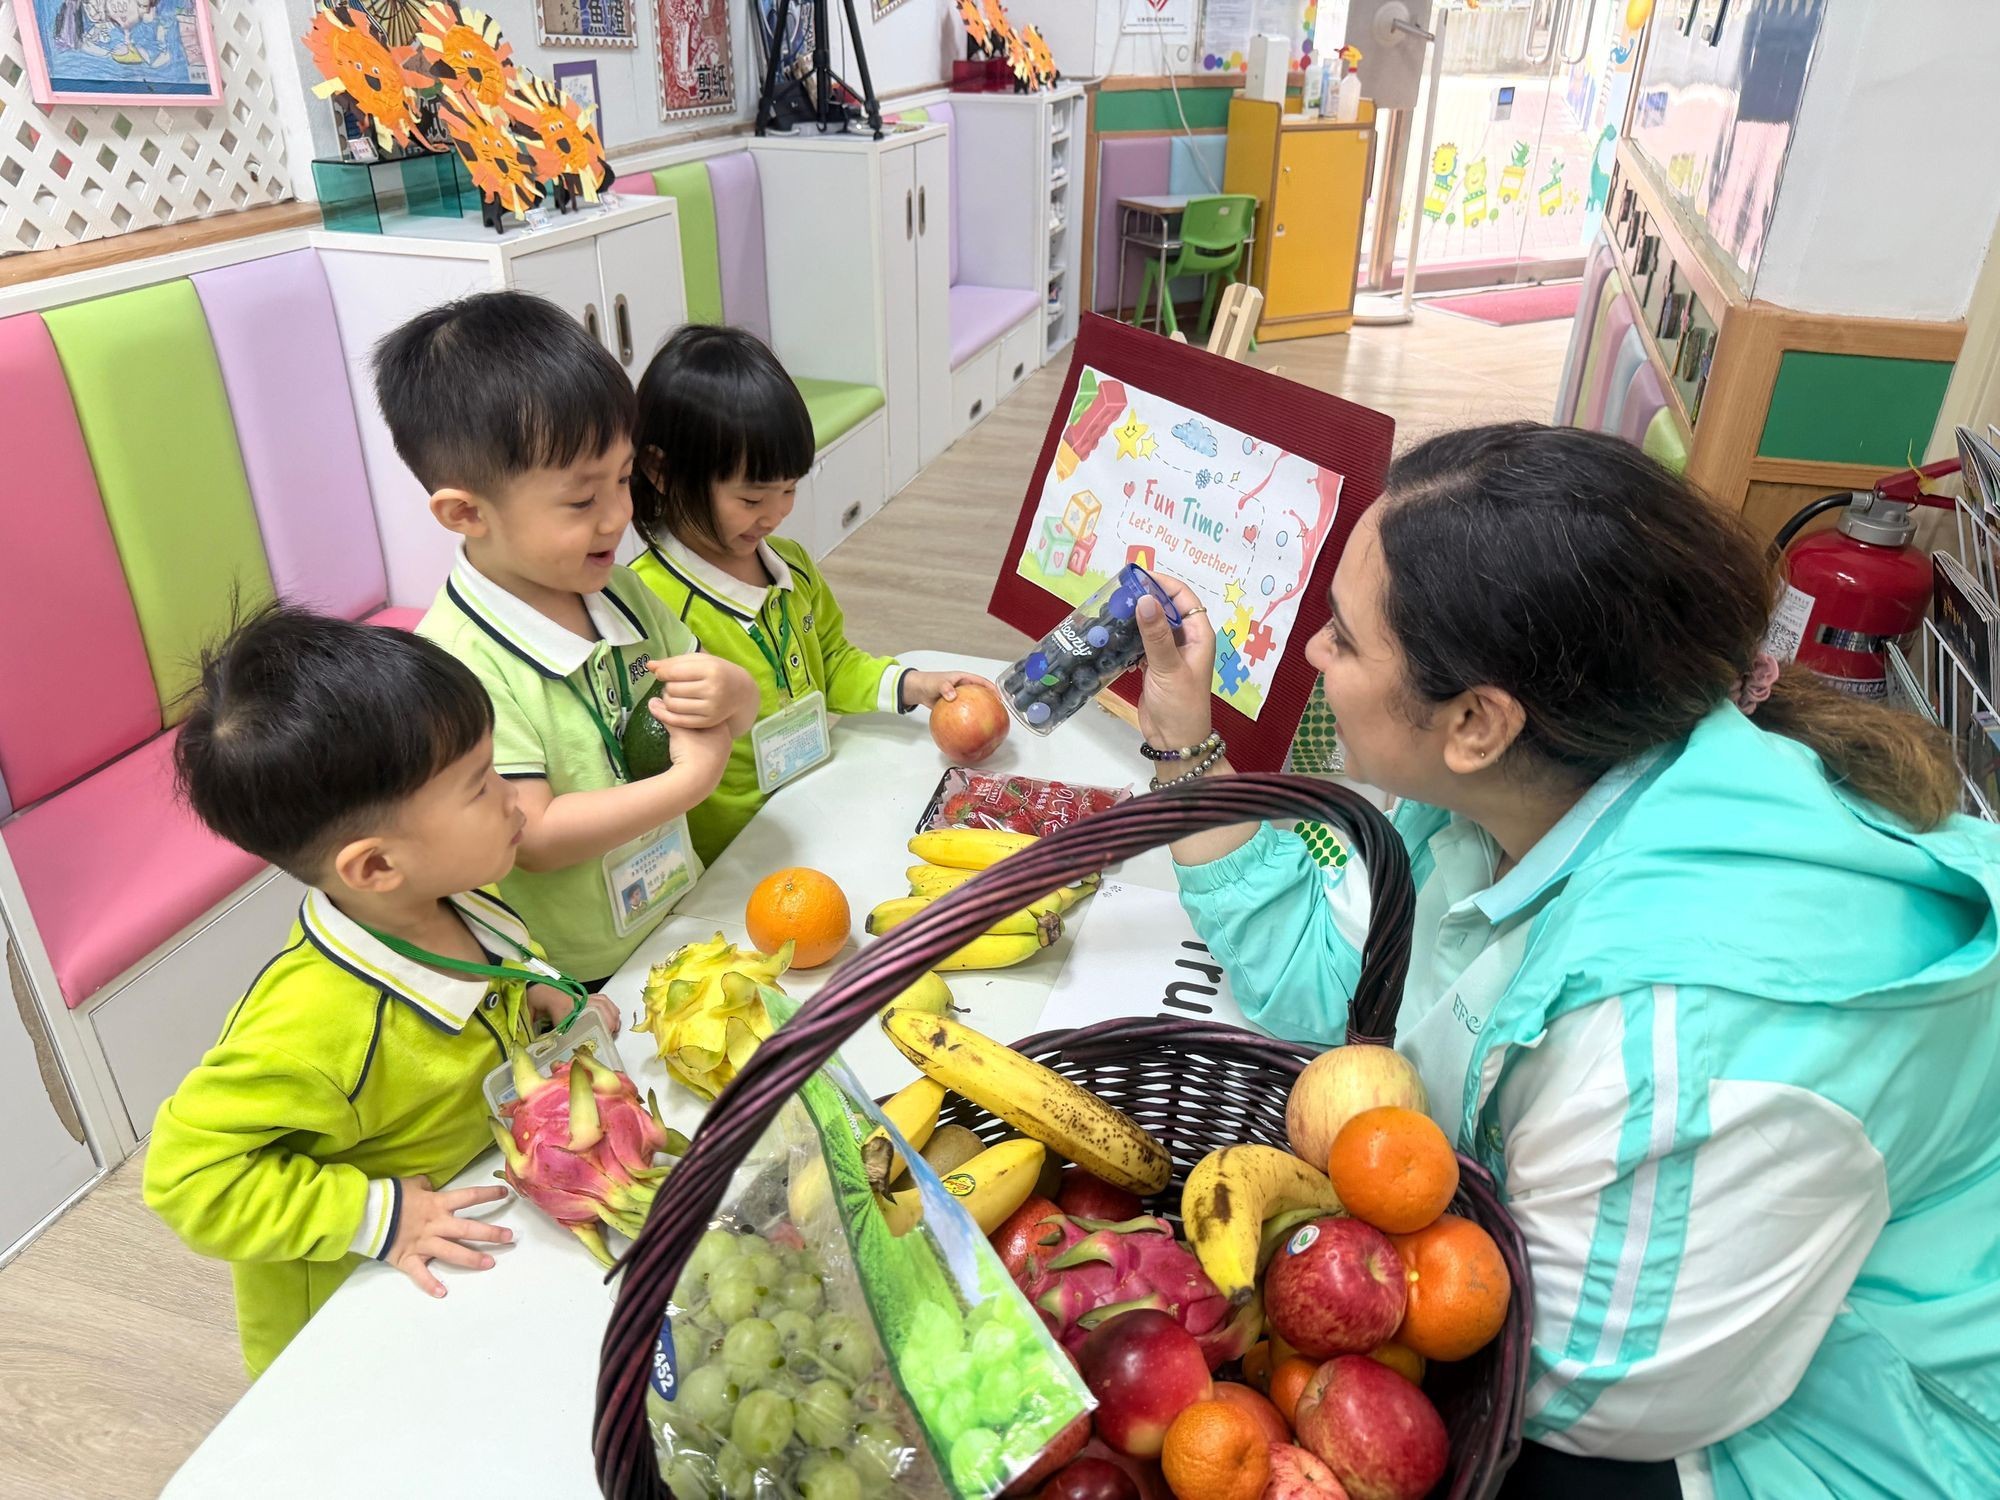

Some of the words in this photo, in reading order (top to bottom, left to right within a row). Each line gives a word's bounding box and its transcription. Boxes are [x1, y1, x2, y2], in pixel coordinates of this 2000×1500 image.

[697, 63, 729, 100] 剪紙
[1144, 479, 1175, 519] Fun
[1182, 497, 1223, 543] Time
[1128, 511, 1154, 535] Let's
[1154, 525, 1180, 552] Play
[1182, 538, 1238, 578] Together!
